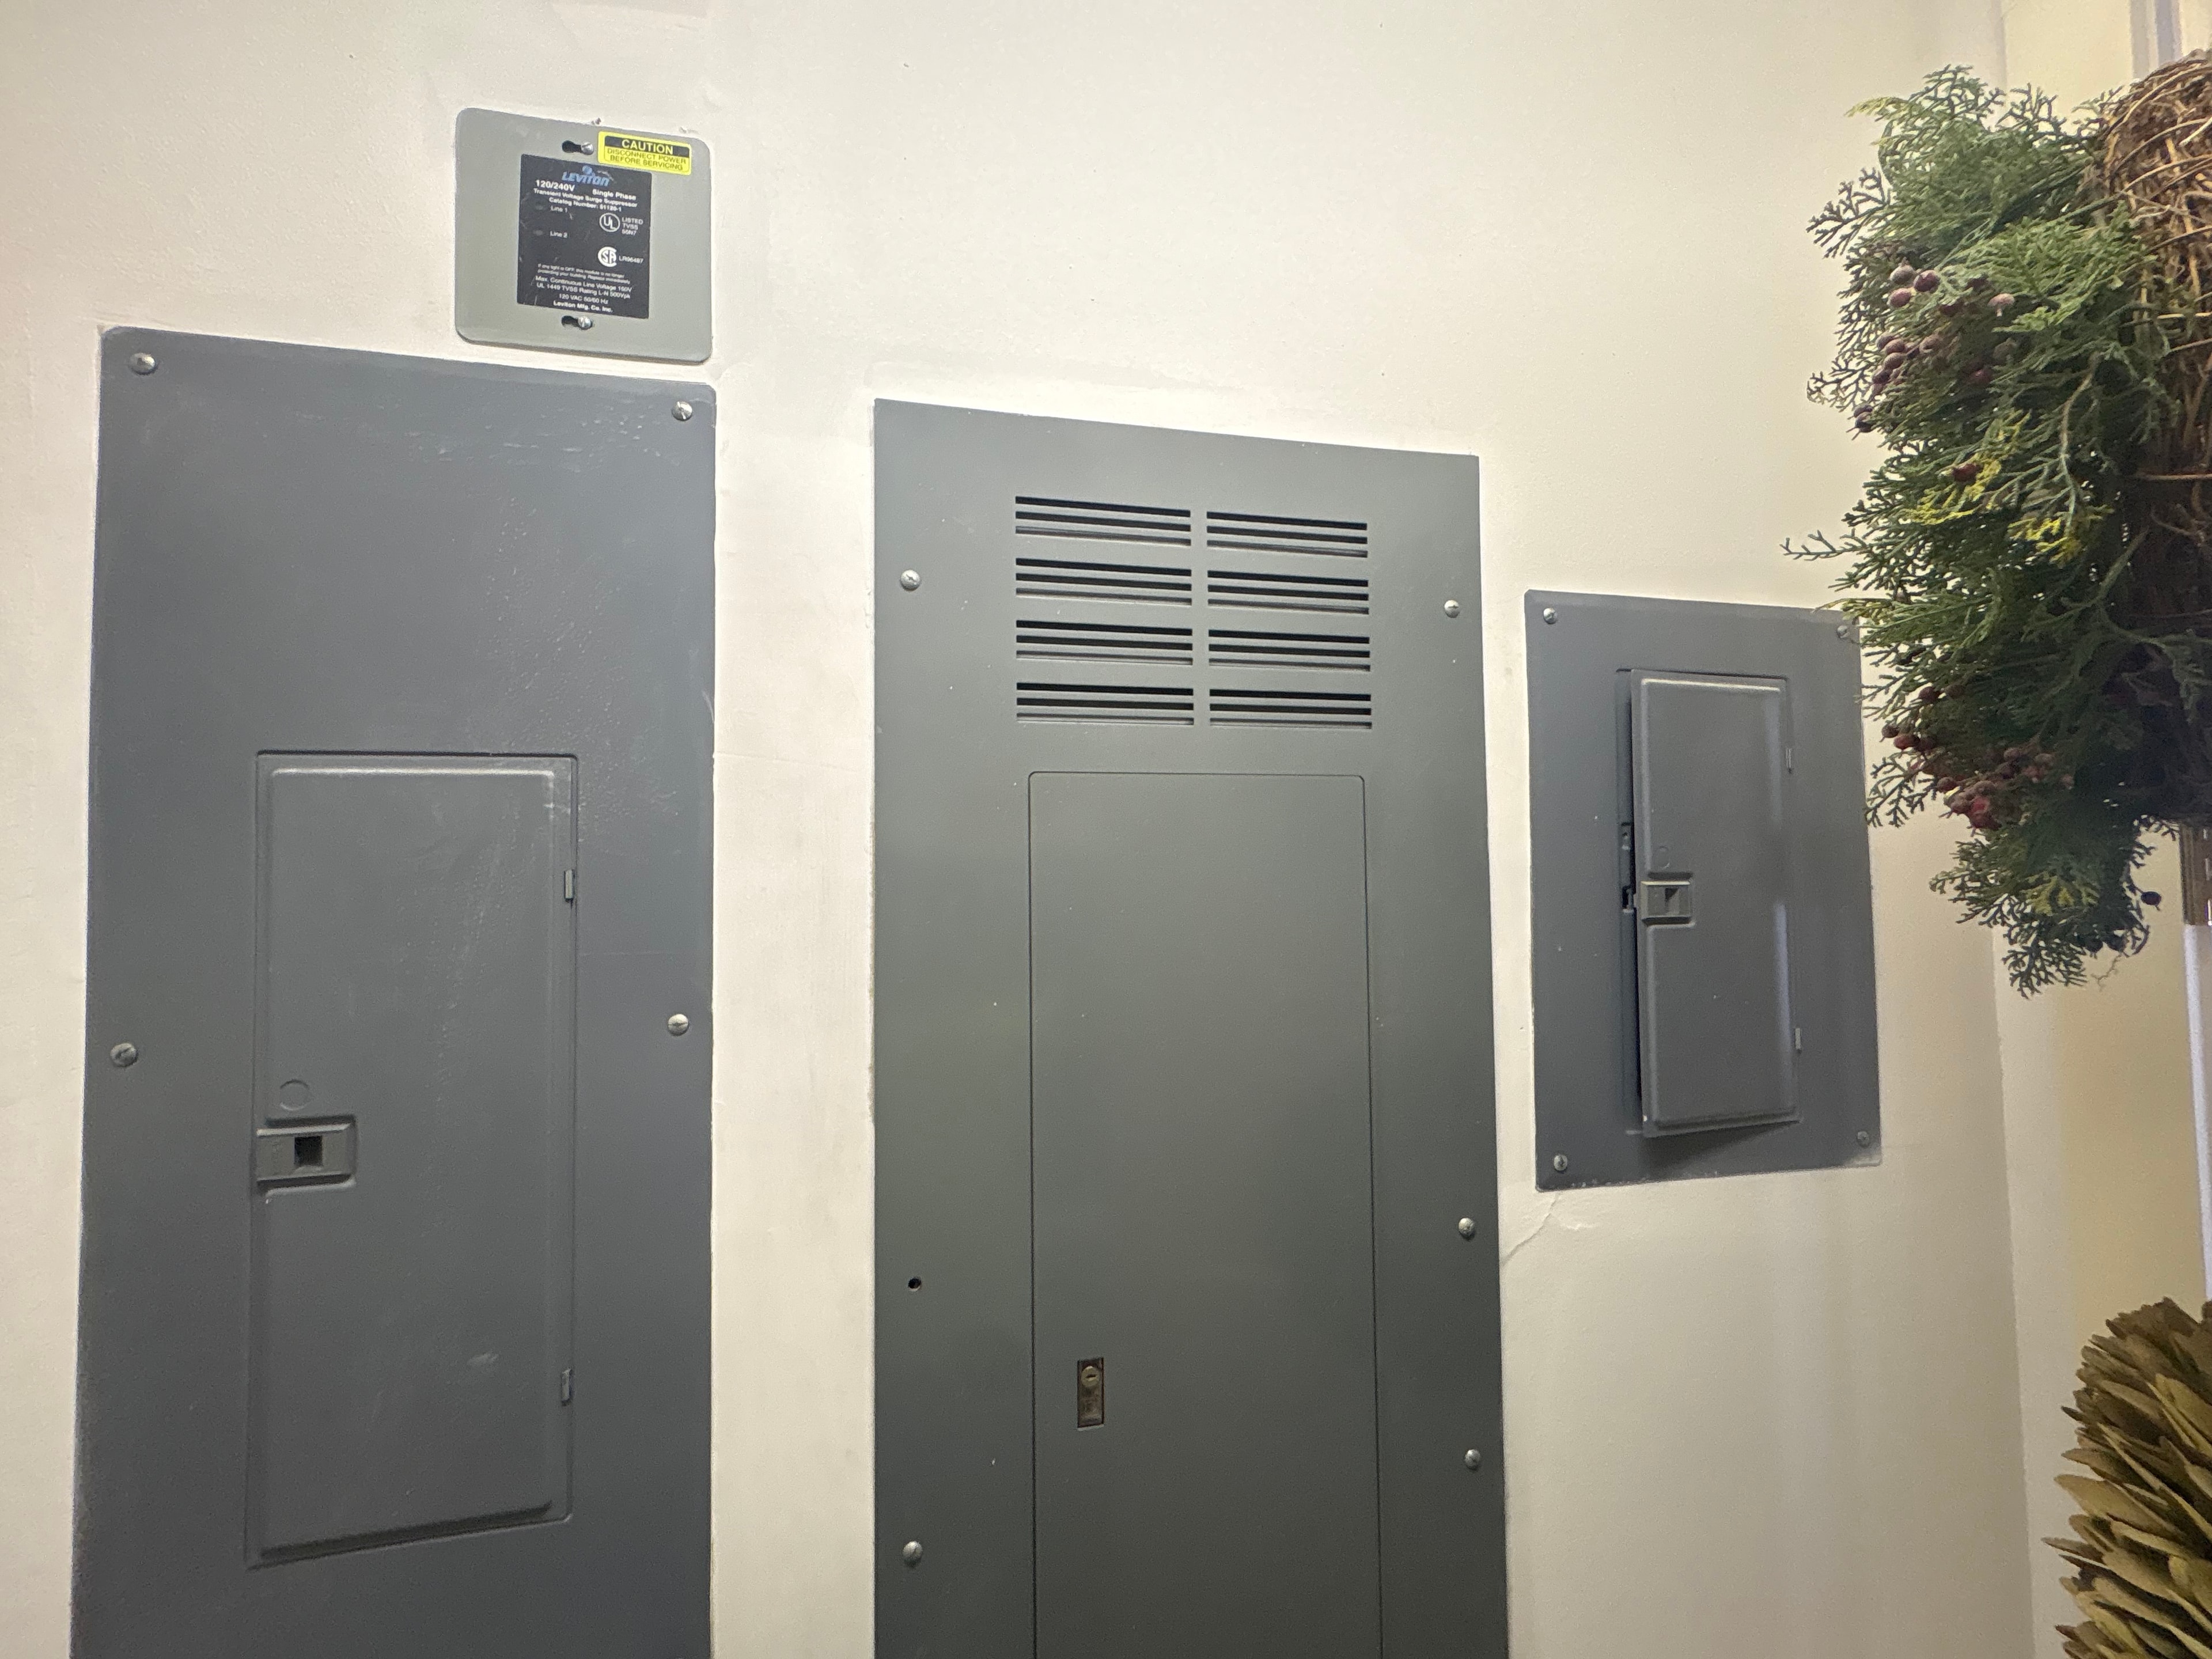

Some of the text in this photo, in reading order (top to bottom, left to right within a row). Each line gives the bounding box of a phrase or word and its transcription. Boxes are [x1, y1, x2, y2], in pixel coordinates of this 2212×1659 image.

[622, 139, 673, 155] CAUTION
[607, 148, 686, 164] DISCONNECT POWER
[610, 155, 683, 171] BEFORE SERVICING
[535, 179, 575, 192] 120/240V
[533, 188, 638, 207] Transient Voltage Surge Suppressor
[548, 196, 573, 206] Catalog
[592, 188, 637, 200] Single Phase
[622, 217, 643, 225] LISTED
[550, 276, 582, 286] Continuous
[596, 283, 616, 291] Voltage
[553, 300, 576, 308] Leviton
[577, 302, 590, 310] Mfg.
